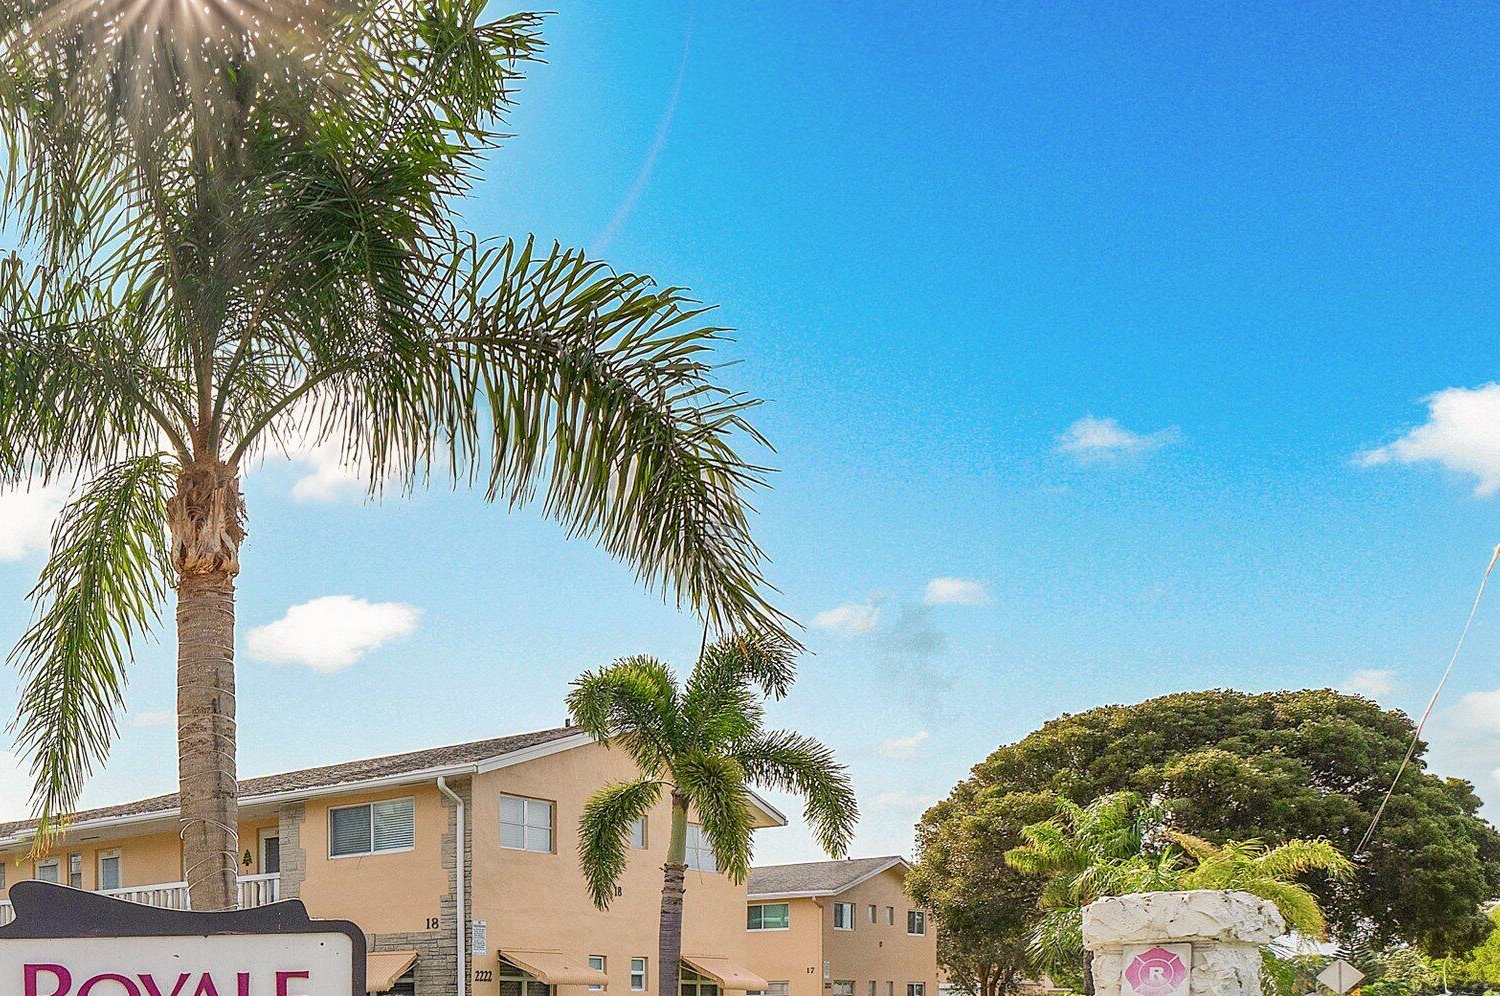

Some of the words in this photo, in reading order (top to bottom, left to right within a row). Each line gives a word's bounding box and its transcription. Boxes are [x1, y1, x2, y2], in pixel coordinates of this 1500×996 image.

[614, 886, 622, 896] 18
[426, 917, 439, 930] 18
[474, 970, 492, 981] 2222
